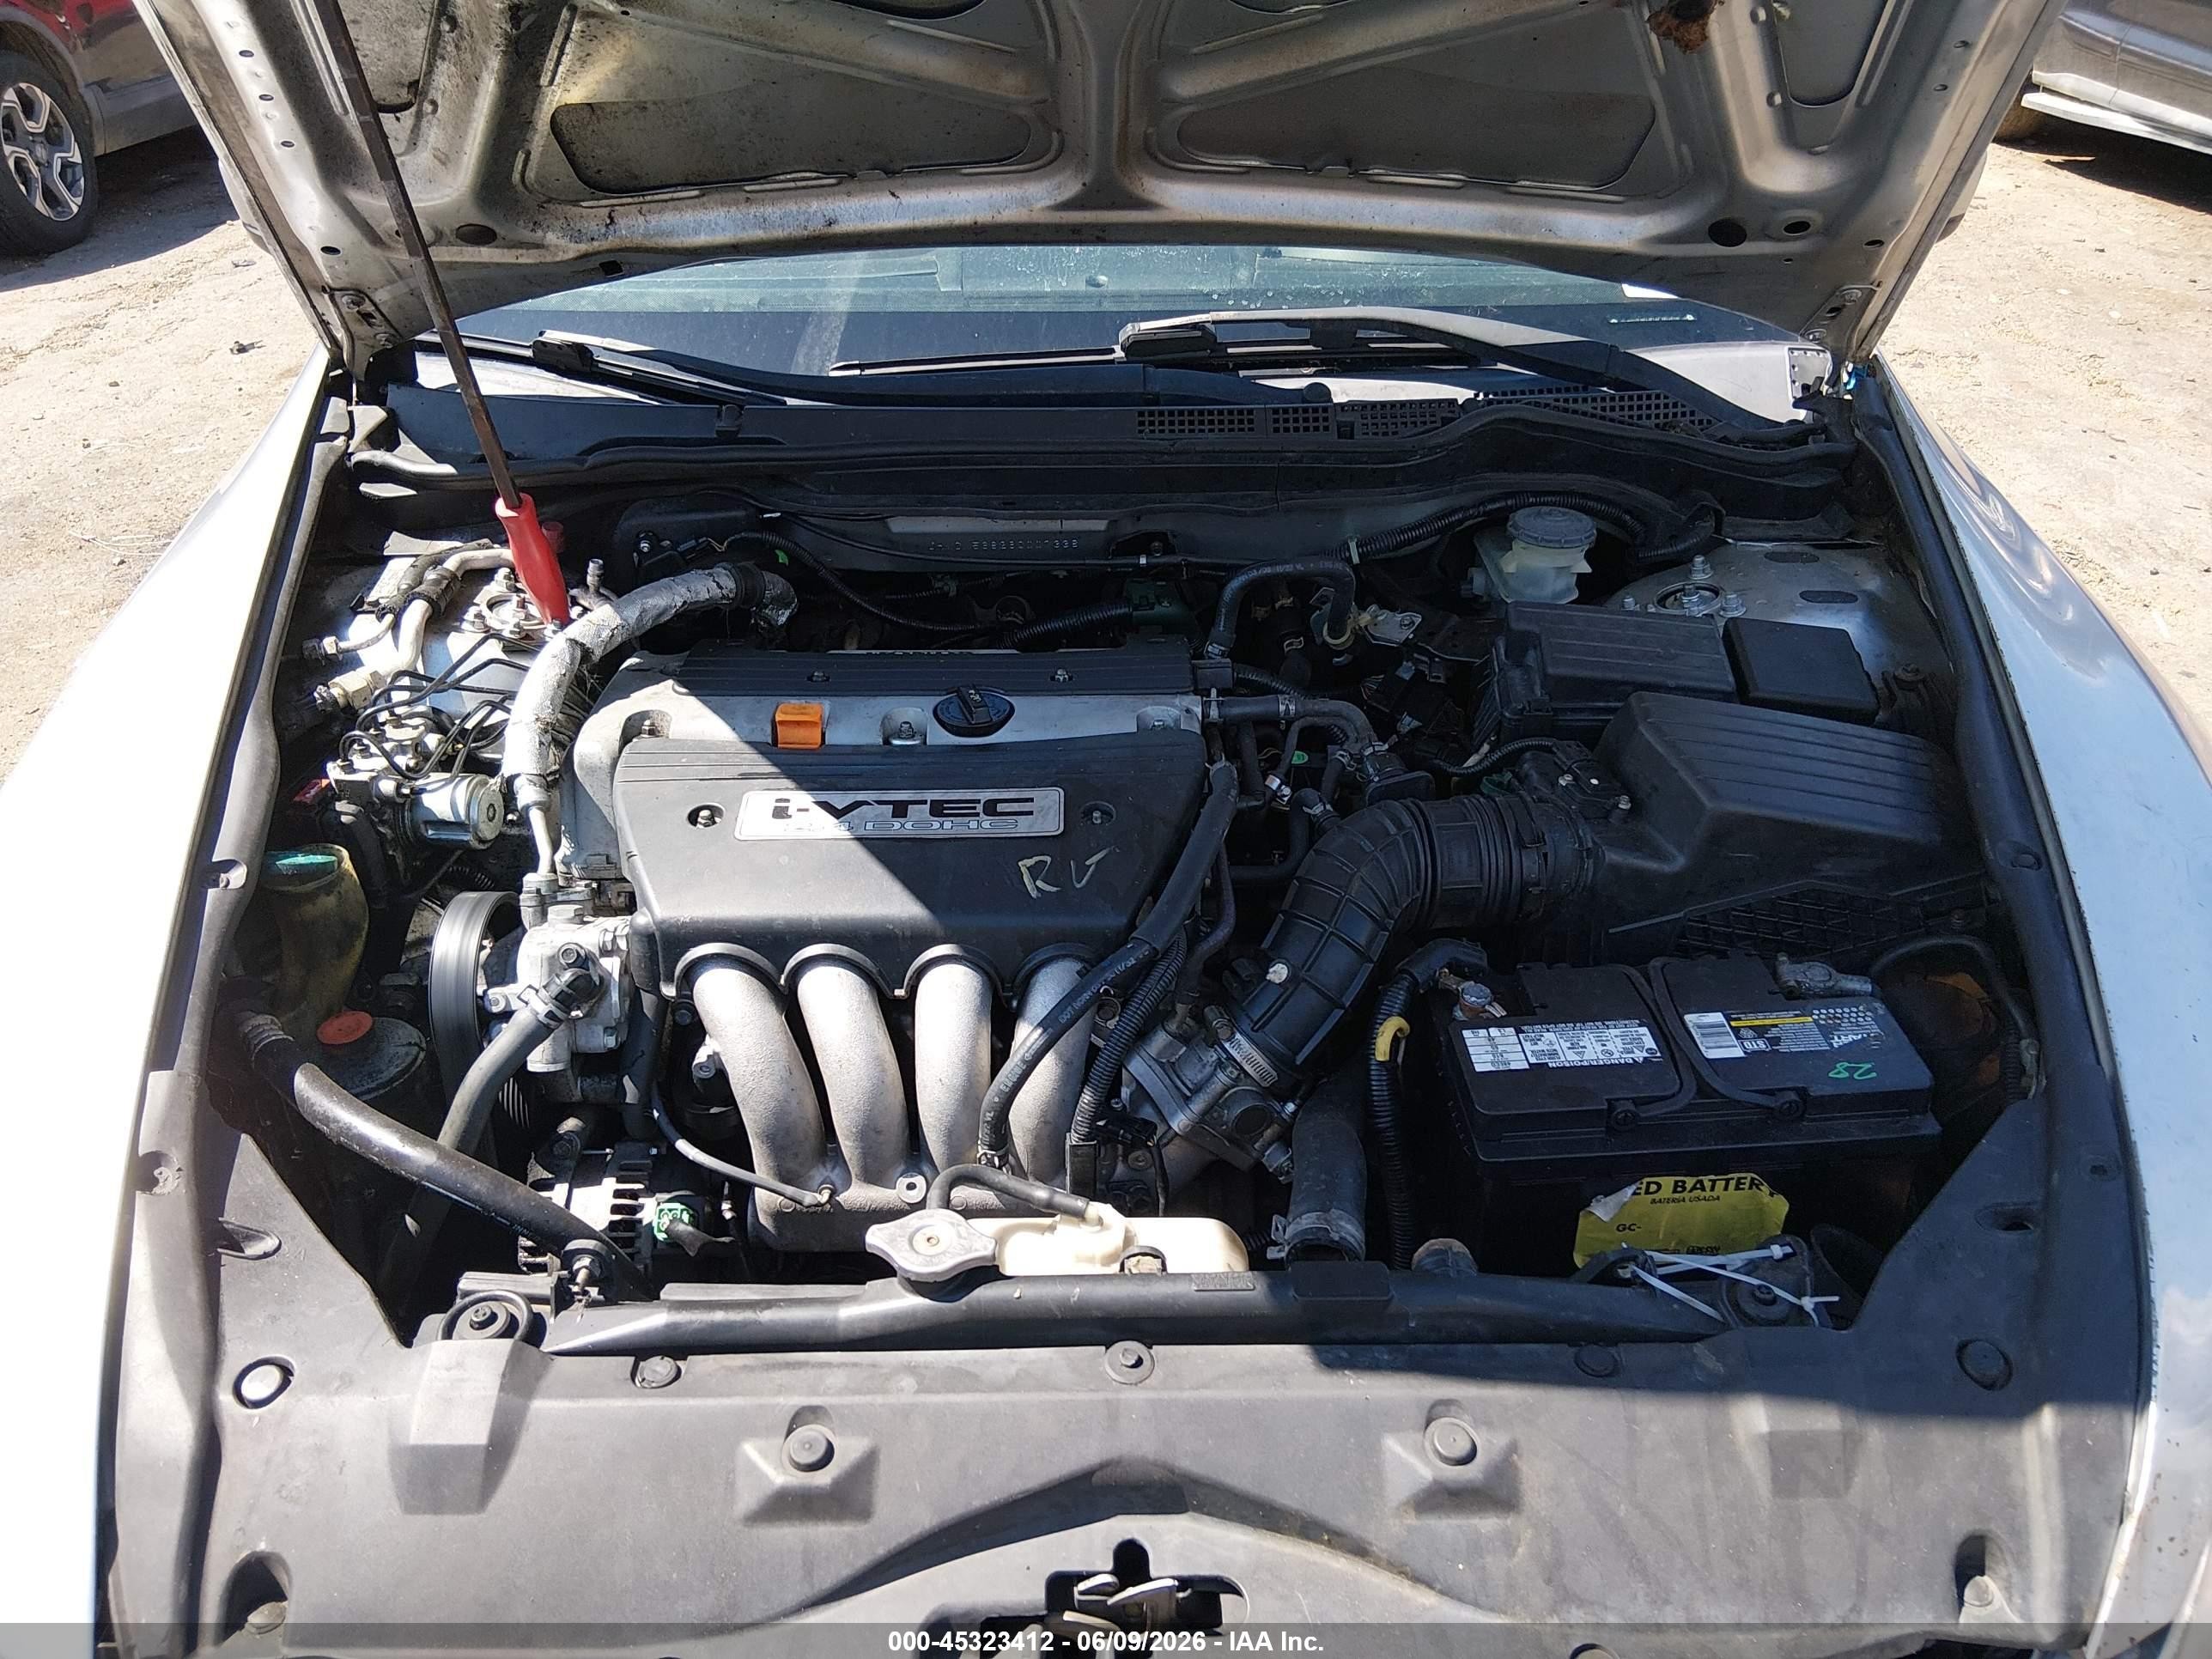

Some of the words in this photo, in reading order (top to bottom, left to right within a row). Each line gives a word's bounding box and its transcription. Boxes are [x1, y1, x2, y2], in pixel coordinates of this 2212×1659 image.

[772, 798, 1035, 819] i-VTEC
[864, 819, 1018, 831] DOHC
[1744, 1041, 1766, 1049] STD
[1548, 1058, 1632, 1068] DANGER/POISON
[1828, 1061, 1877, 1079] 28
[1616, 1223, 1642, 1232] GC-
